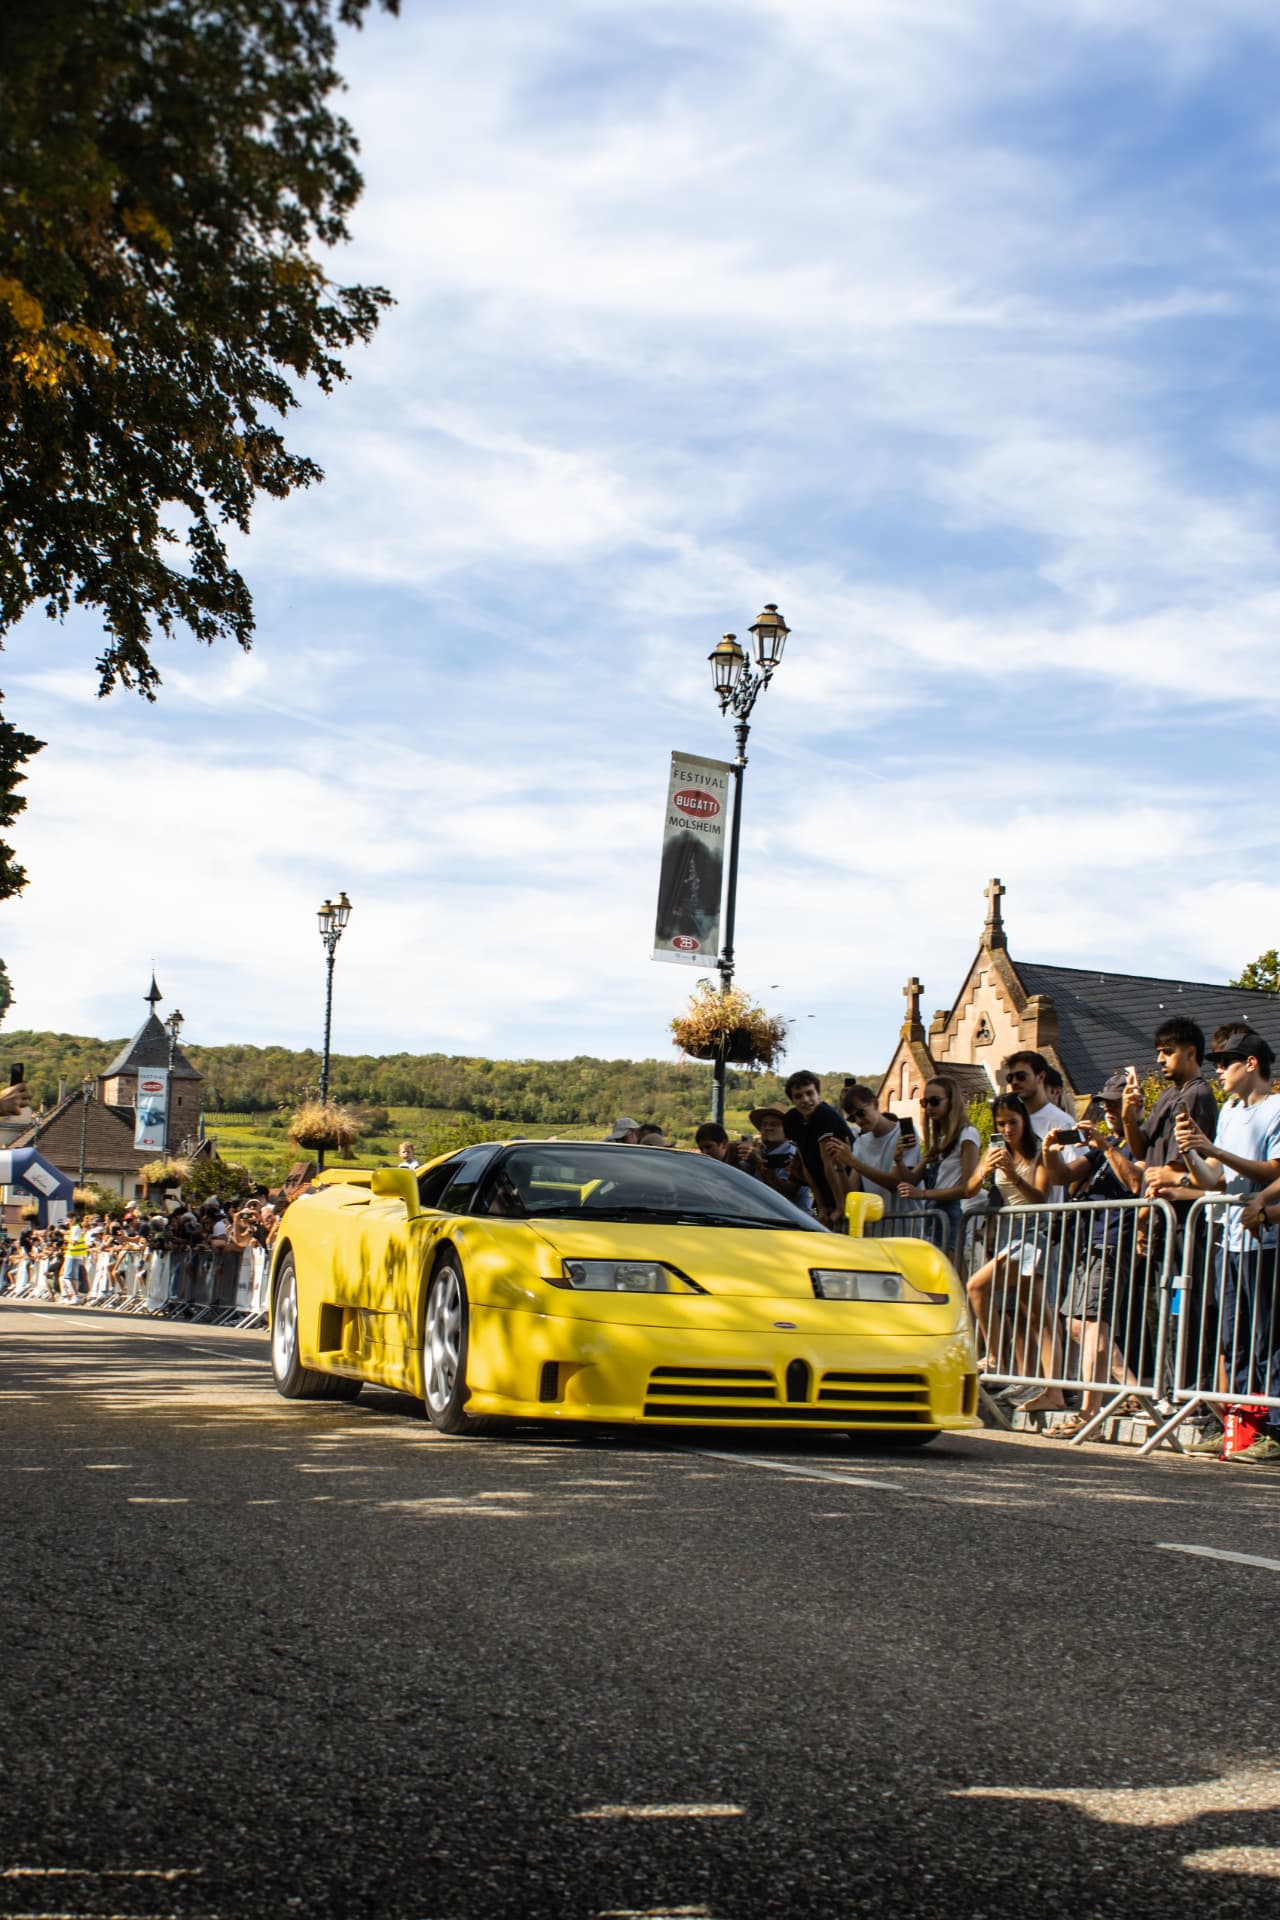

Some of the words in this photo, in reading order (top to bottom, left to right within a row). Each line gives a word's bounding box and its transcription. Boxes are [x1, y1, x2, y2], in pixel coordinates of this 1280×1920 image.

[673, 769, 725, 789] FESTIVAL
[676, 795, 718, 813] BUGATTI
[668, 815, 721, 835] MOLSHEIM
